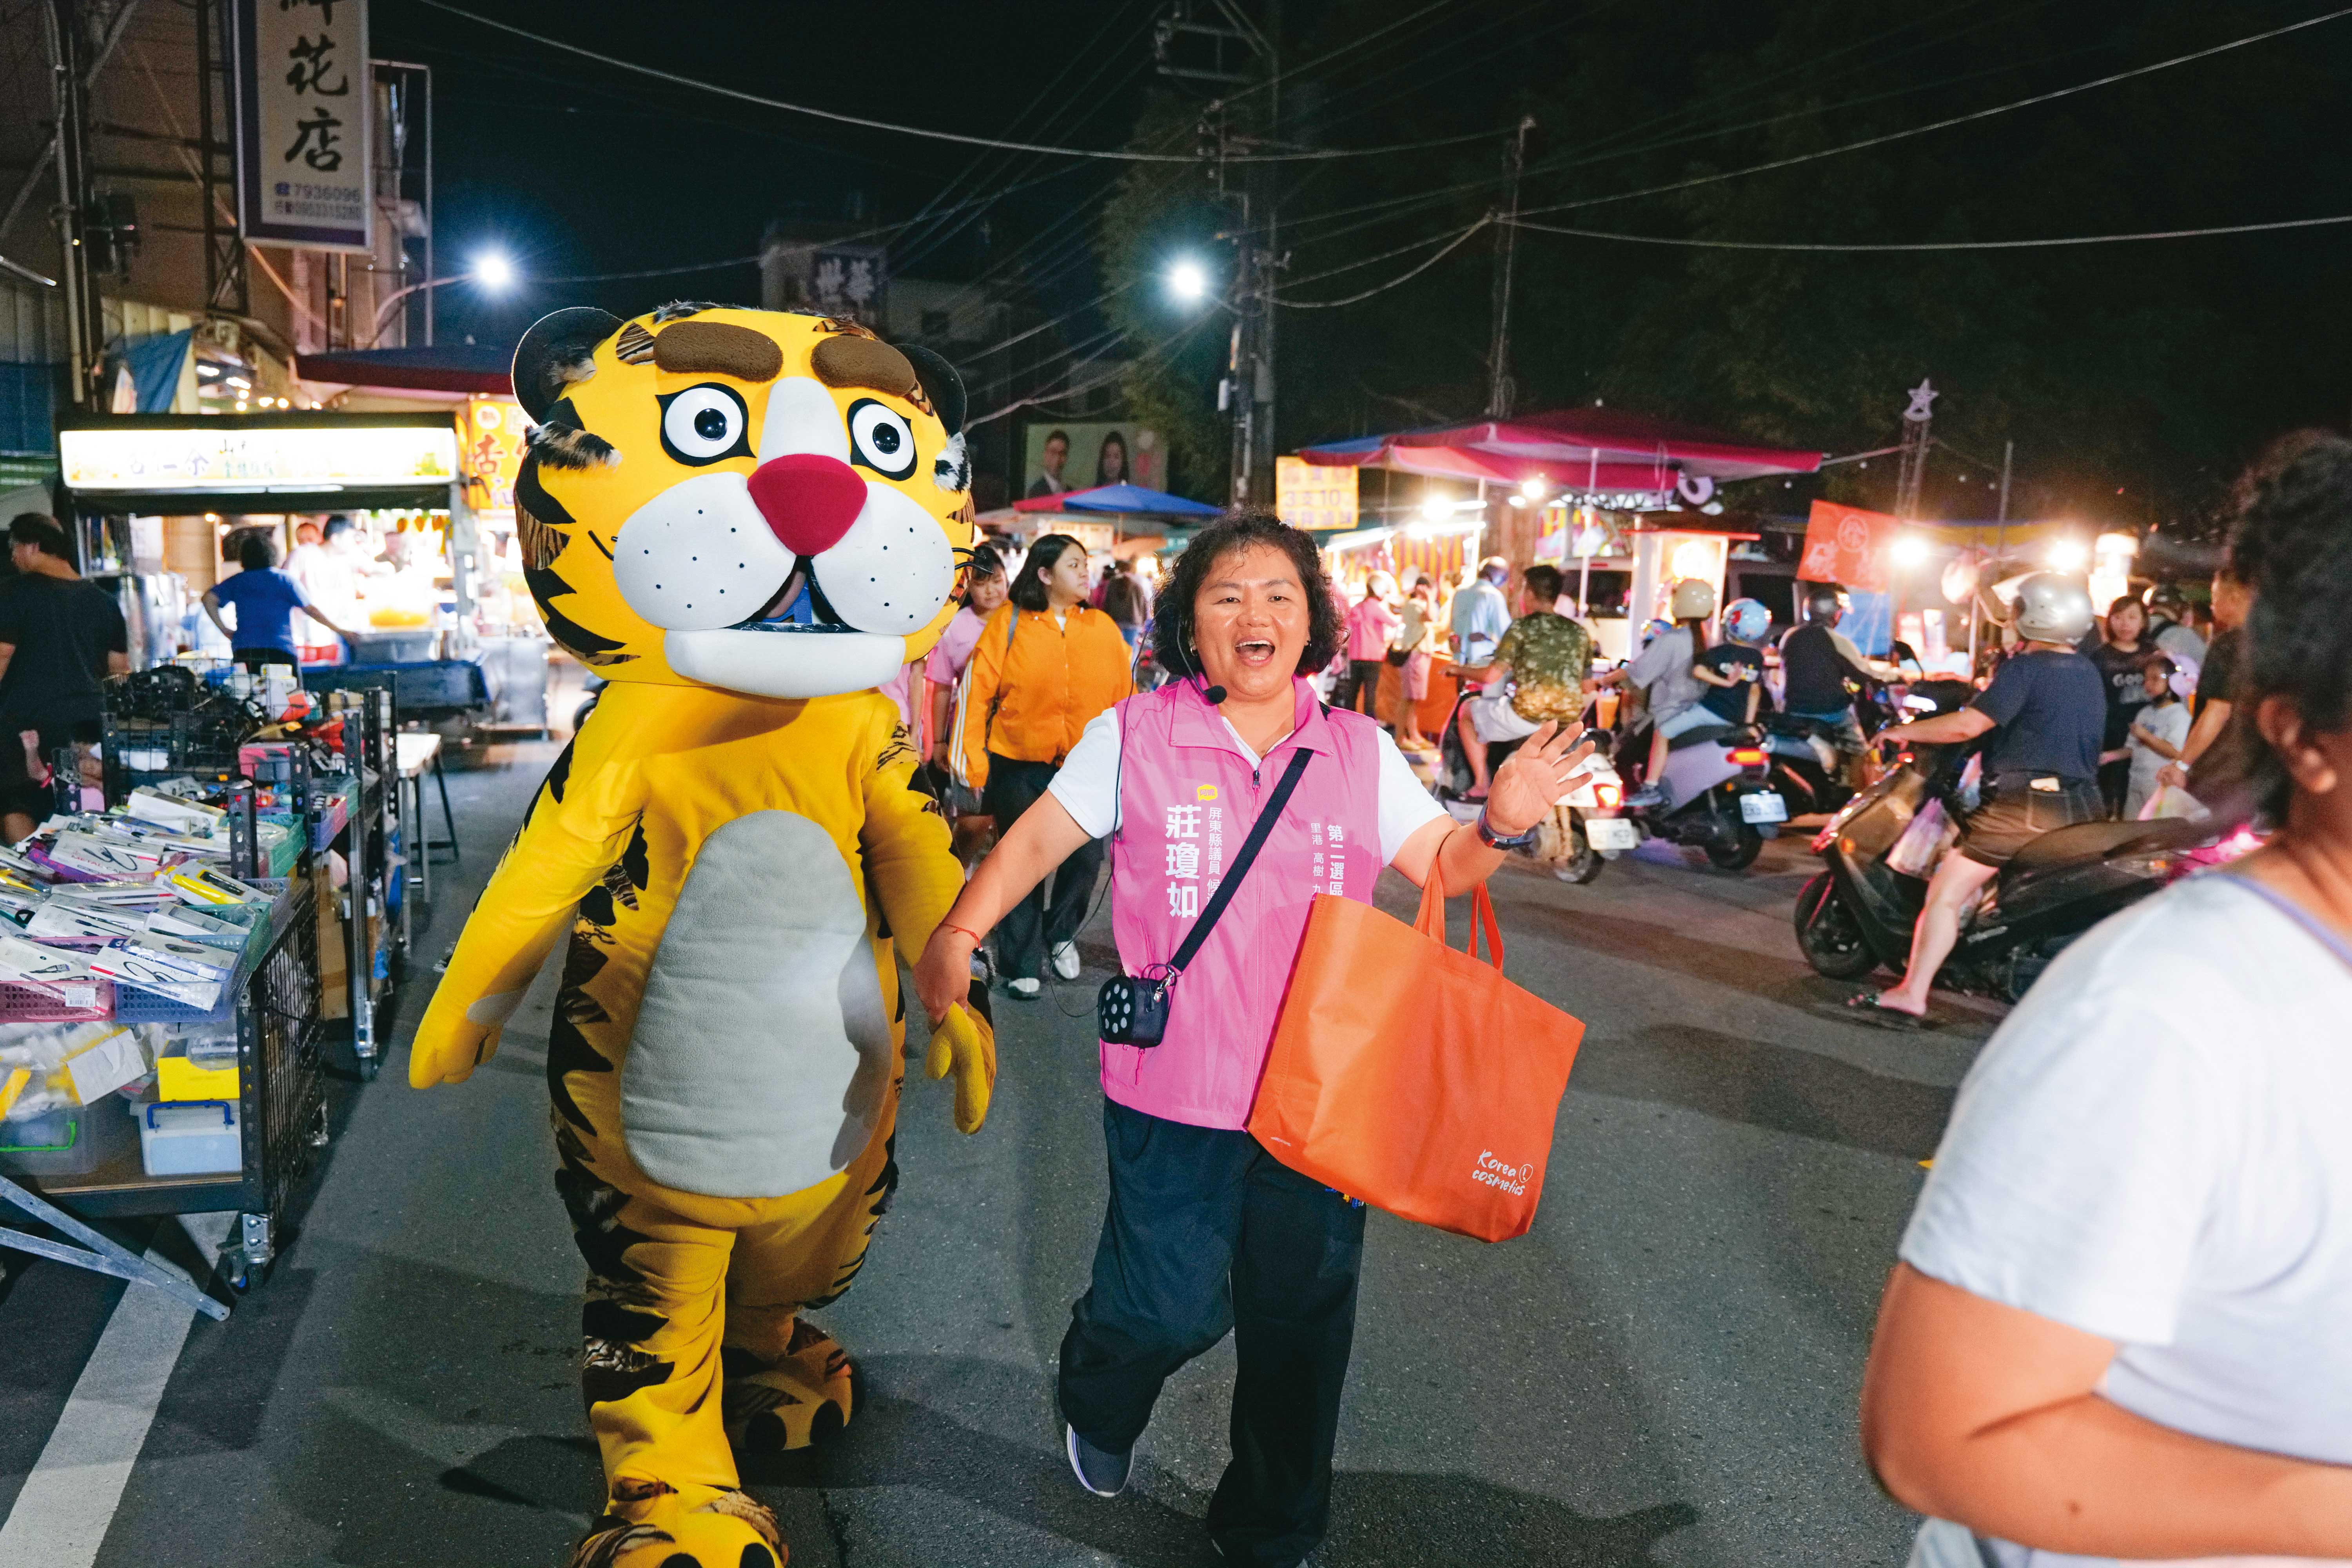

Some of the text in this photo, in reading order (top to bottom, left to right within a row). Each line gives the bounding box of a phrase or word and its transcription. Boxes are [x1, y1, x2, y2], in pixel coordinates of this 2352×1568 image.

[1200, 788, 1216, 797] 阿嬤
[1208, 807, 1223, 875] 屏東縣議員
[1310, 823, 1323, 846] 里港
[1165, 804, 1202, 918] 莊瓊如
[1312, 852, 1324, 877] 高樹
[1327, 824, 1345, 896] 第二選區
[1477, 1149, 1516, 1178] Korea
[1472, 1169, 1526, 1196] cosmetics
